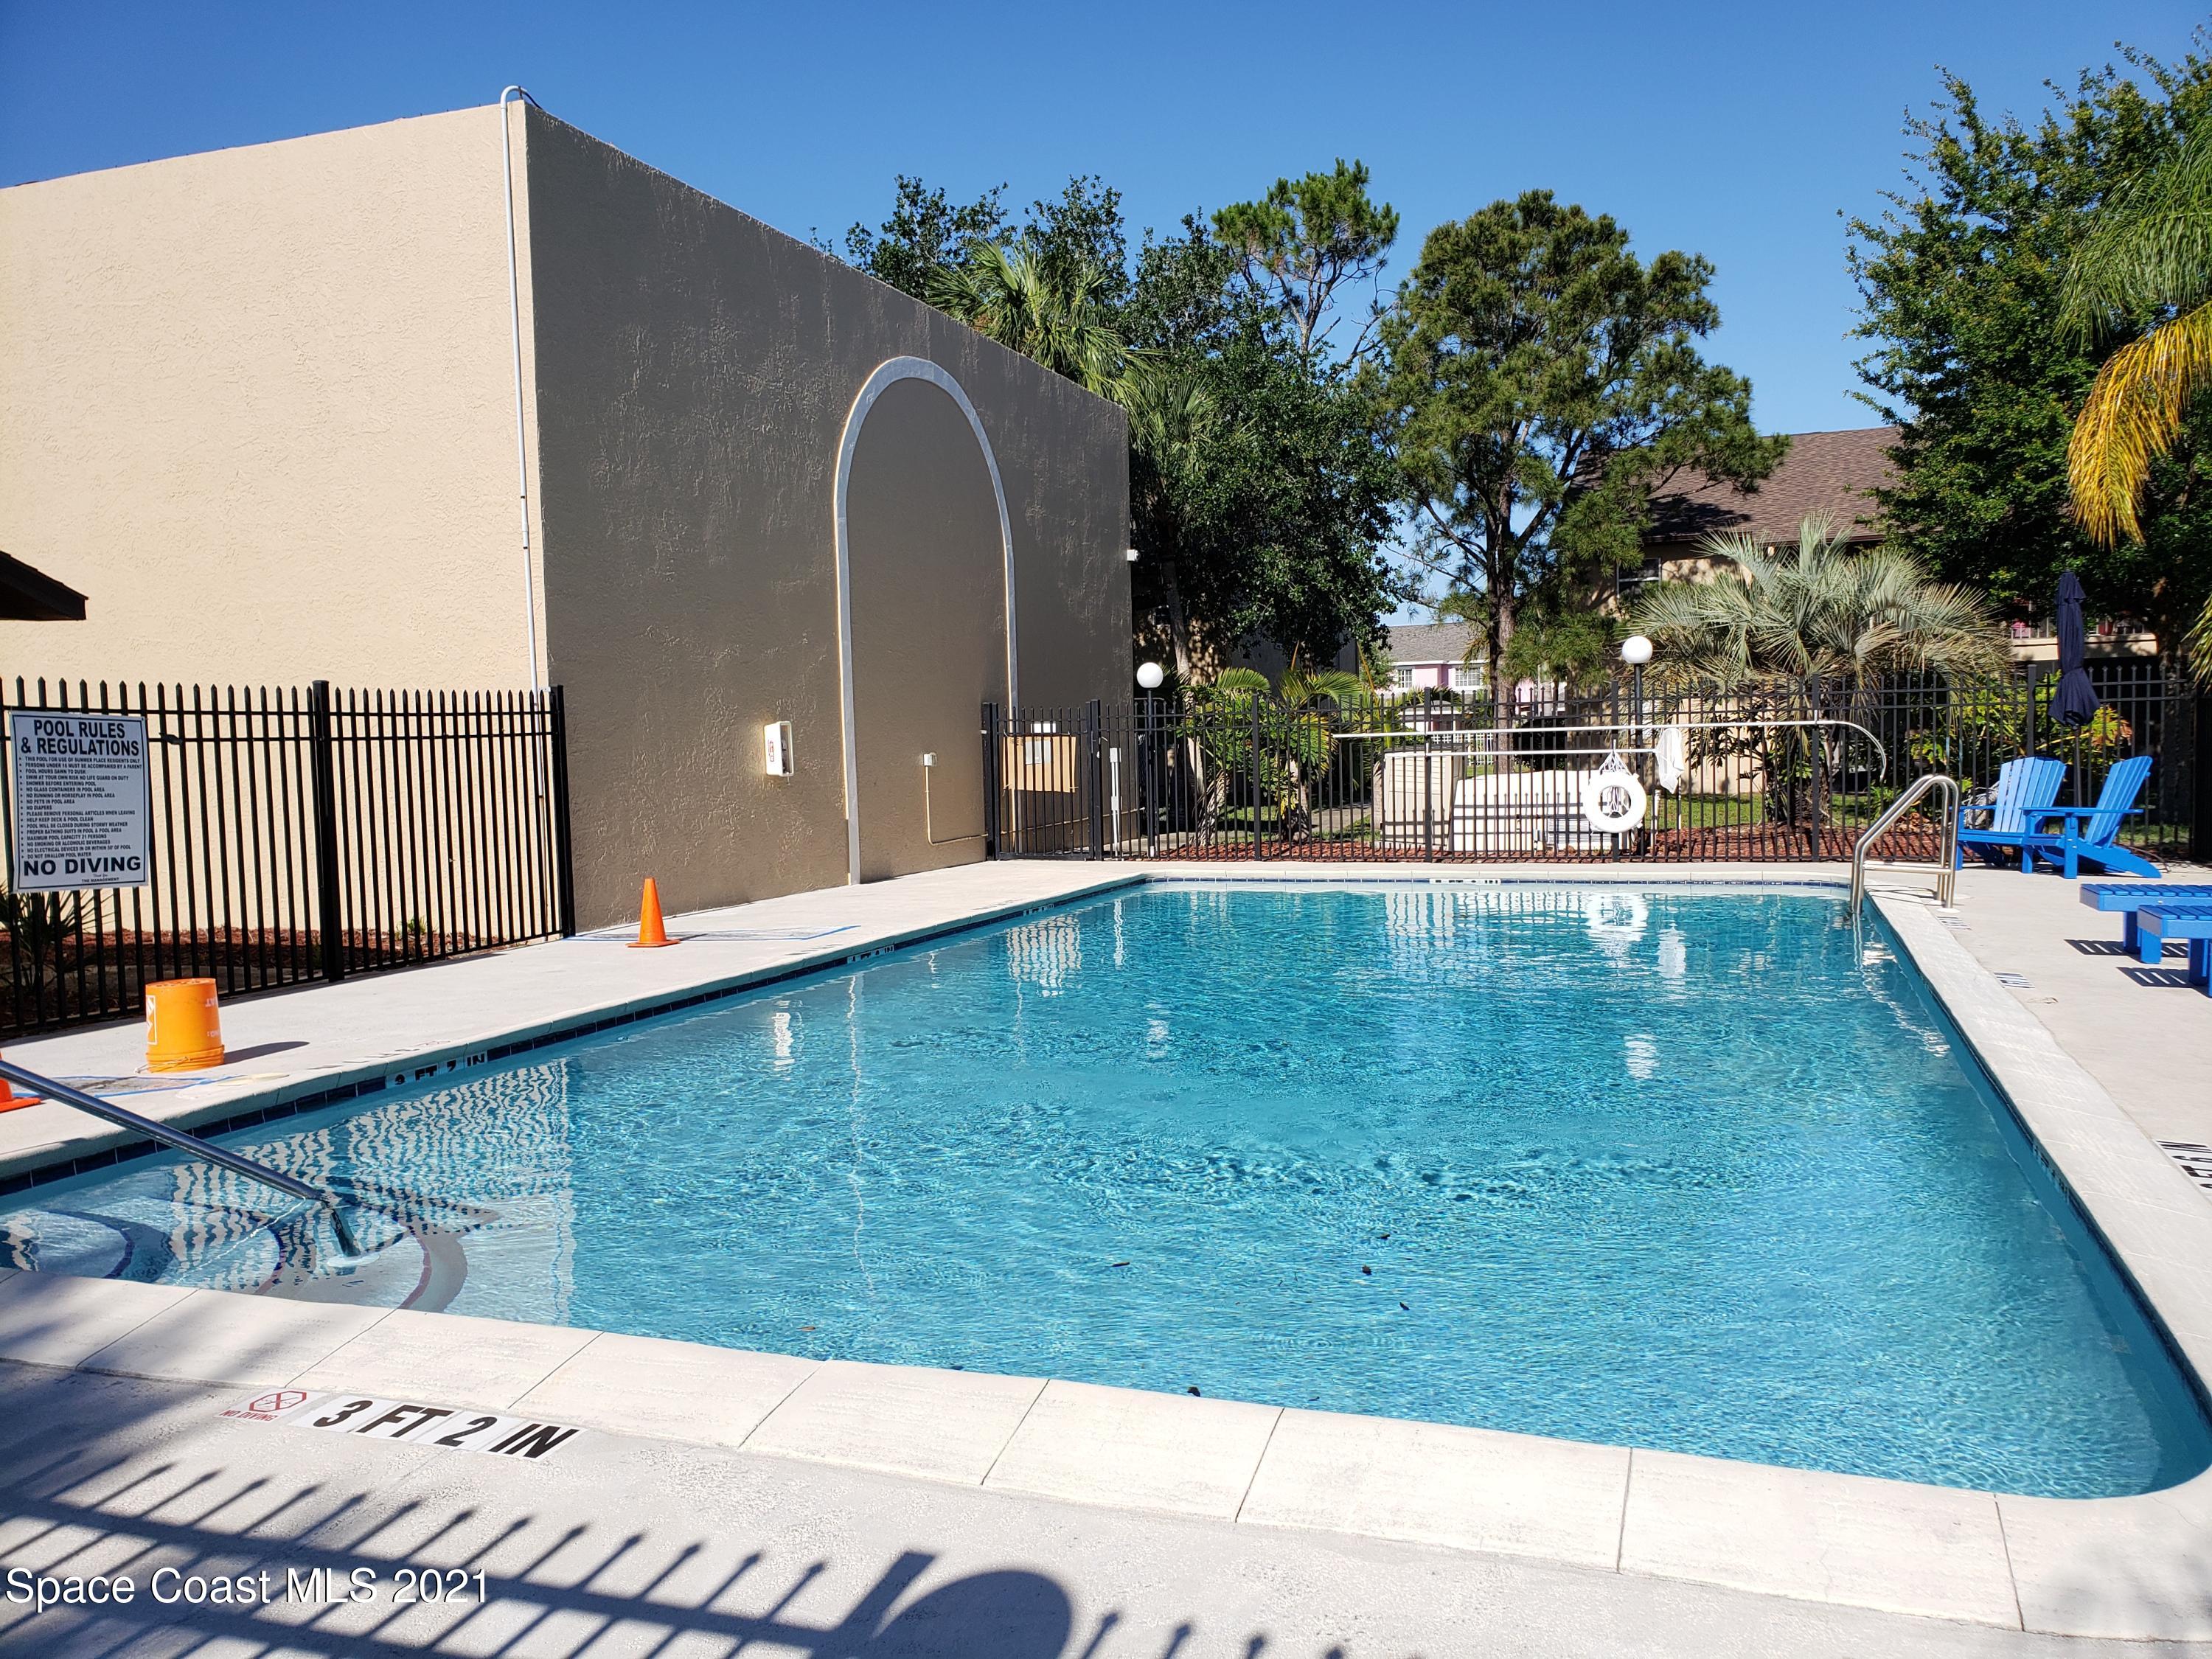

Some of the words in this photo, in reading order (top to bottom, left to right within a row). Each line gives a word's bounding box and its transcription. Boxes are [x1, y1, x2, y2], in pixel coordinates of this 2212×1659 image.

[34, 720, 74, 737] POOL
[79, 722, 125, 738] RULES
[21, 737, 31, 753] &
[37, 737, 139, 756] REGULATIONS
[24, 859, 56, 876] NO
[65, 856, 141, 874] DIVING
[467, 1054, 485, 1066] IN
[237, 1412, 278, 1421] DIVING
[314, 1400, 374, 1427] 3
[366, 1404, 450, 1439] FT
[435, 1416, 498, 1447] 2
[490, 1423, 578, 1459] IN
